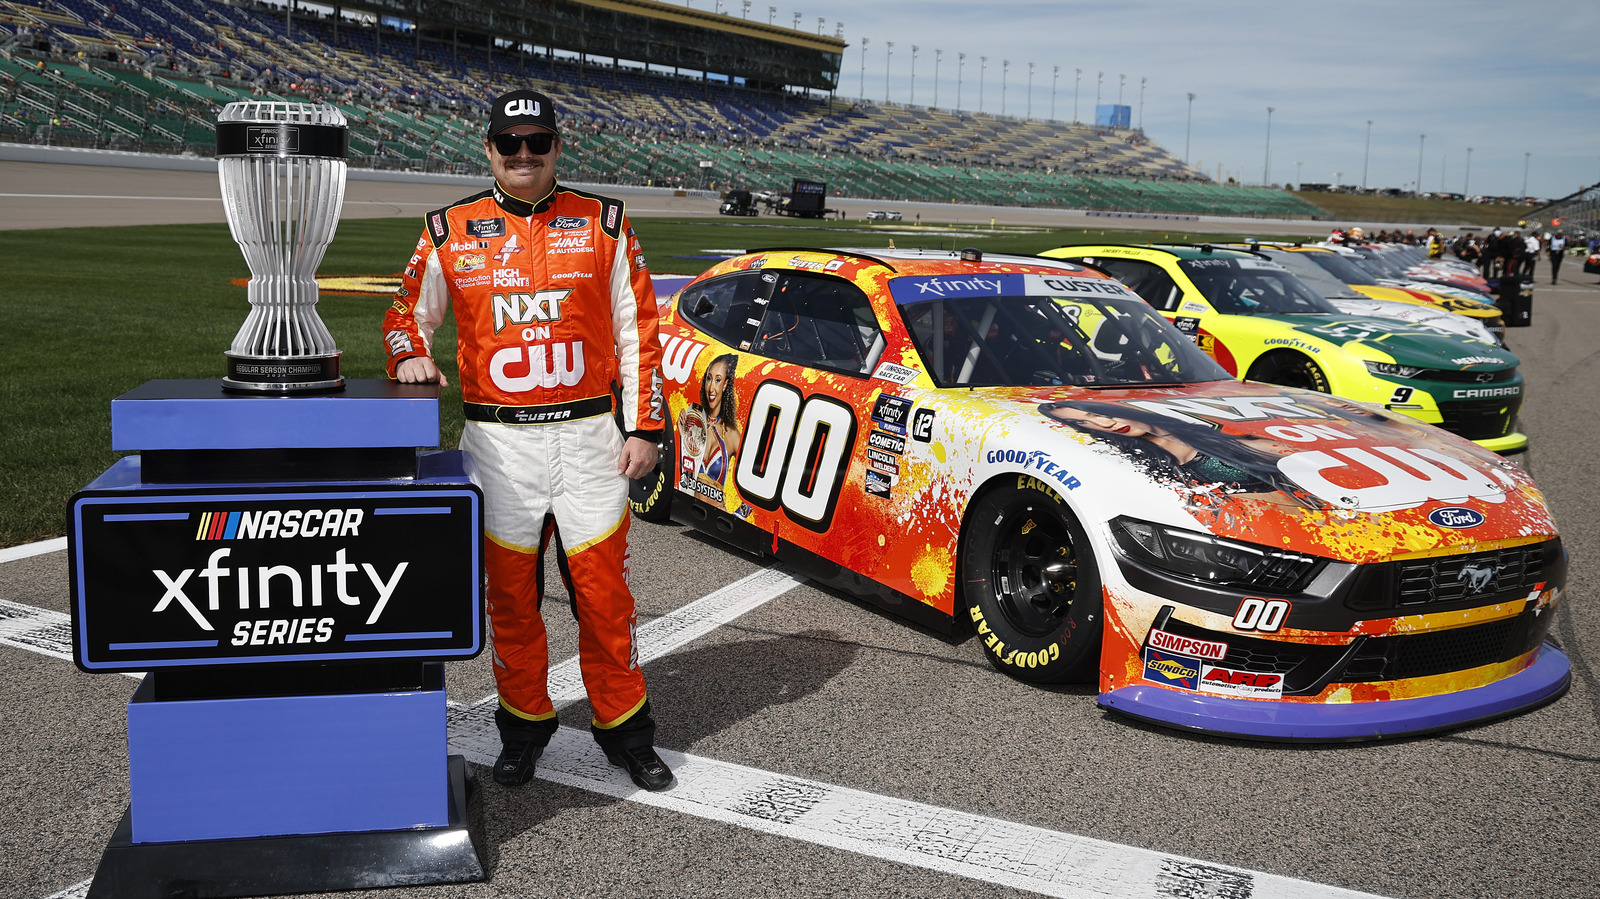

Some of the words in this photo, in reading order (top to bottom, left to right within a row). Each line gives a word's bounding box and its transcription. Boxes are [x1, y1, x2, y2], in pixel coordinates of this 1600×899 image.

[504, 99, 541, 117] CW
[555, 217, 580, 228] Ford
[607, 206, 617, 228] SIMPSON
[473, 222, 499, 233] xfinity
[450, 240, 478, 252] Mobil
[549, 235, 591, 248] HAAS
[556, 246, 595, 254] AUTODESK
[492, 268, 519, 278] HIGH
[493, 277, 525, 288] POINT
[551, 270, 593, 279] GOODYEAR
[913, 277, 1002, 297] xfinity
[1043, 278, 1131, 297] CUSTER
[491, 288, 576, 336] NXT
[521, 326, 551, 342] ON
[1264, 338, 1321, 354] GOODYEAR
[236, 365, 259, 373] REGULAR
[260, 366, 287, 374] SEASON
[288, 365, 321, 373] CHAMPION
[489, 341, 585, 393] CW
[893, 373, 906, 382] CAR
[1305, 360, 1325, 394] EAGLE
[1391, 387, 1414, 404] 9
[1453, 386, 1520, 399] CAMARO
[878, 403, 904, 422] xfinity
[1121, 395, 1332, 430] NXT
[916, 413, 934, 438] 12
[1263, 423, 1359, 443] ON
[736, 381, 854, 522] 00
[869, 433, 904, 452] COMETIC
[868, 449, 895, 465] LINCOLN
[873, 460, 897, 473] WELDERS
[986, 449, 1082, 492] GOODYEAR
[1276, 446, 1507, 514] CW
[627, 471, 665, 513] GOODYEA
[688, 479, 697, 491] 3D
[696, 481, 724, 502] SYSTEMS
[1017, 475, 1062, 504] EAGLE
[237, 508, 365, 540] NASCAR
[1439, 510, 1478, 526] Ford
[151, 547, 410, 632] xfinity
[1232, 598, 1290, 632] 00
[230, 617, 335, 647] SERIES
[969, 604, 1061, 669] GOODYEAR
[1152, 632, 1223, 658] SIMPSON
[1148, 660, 1197, 679] SUNOCO
[1202, 667, 1282, 688] ARP
[1201, 680, 1237, 690] automotive
